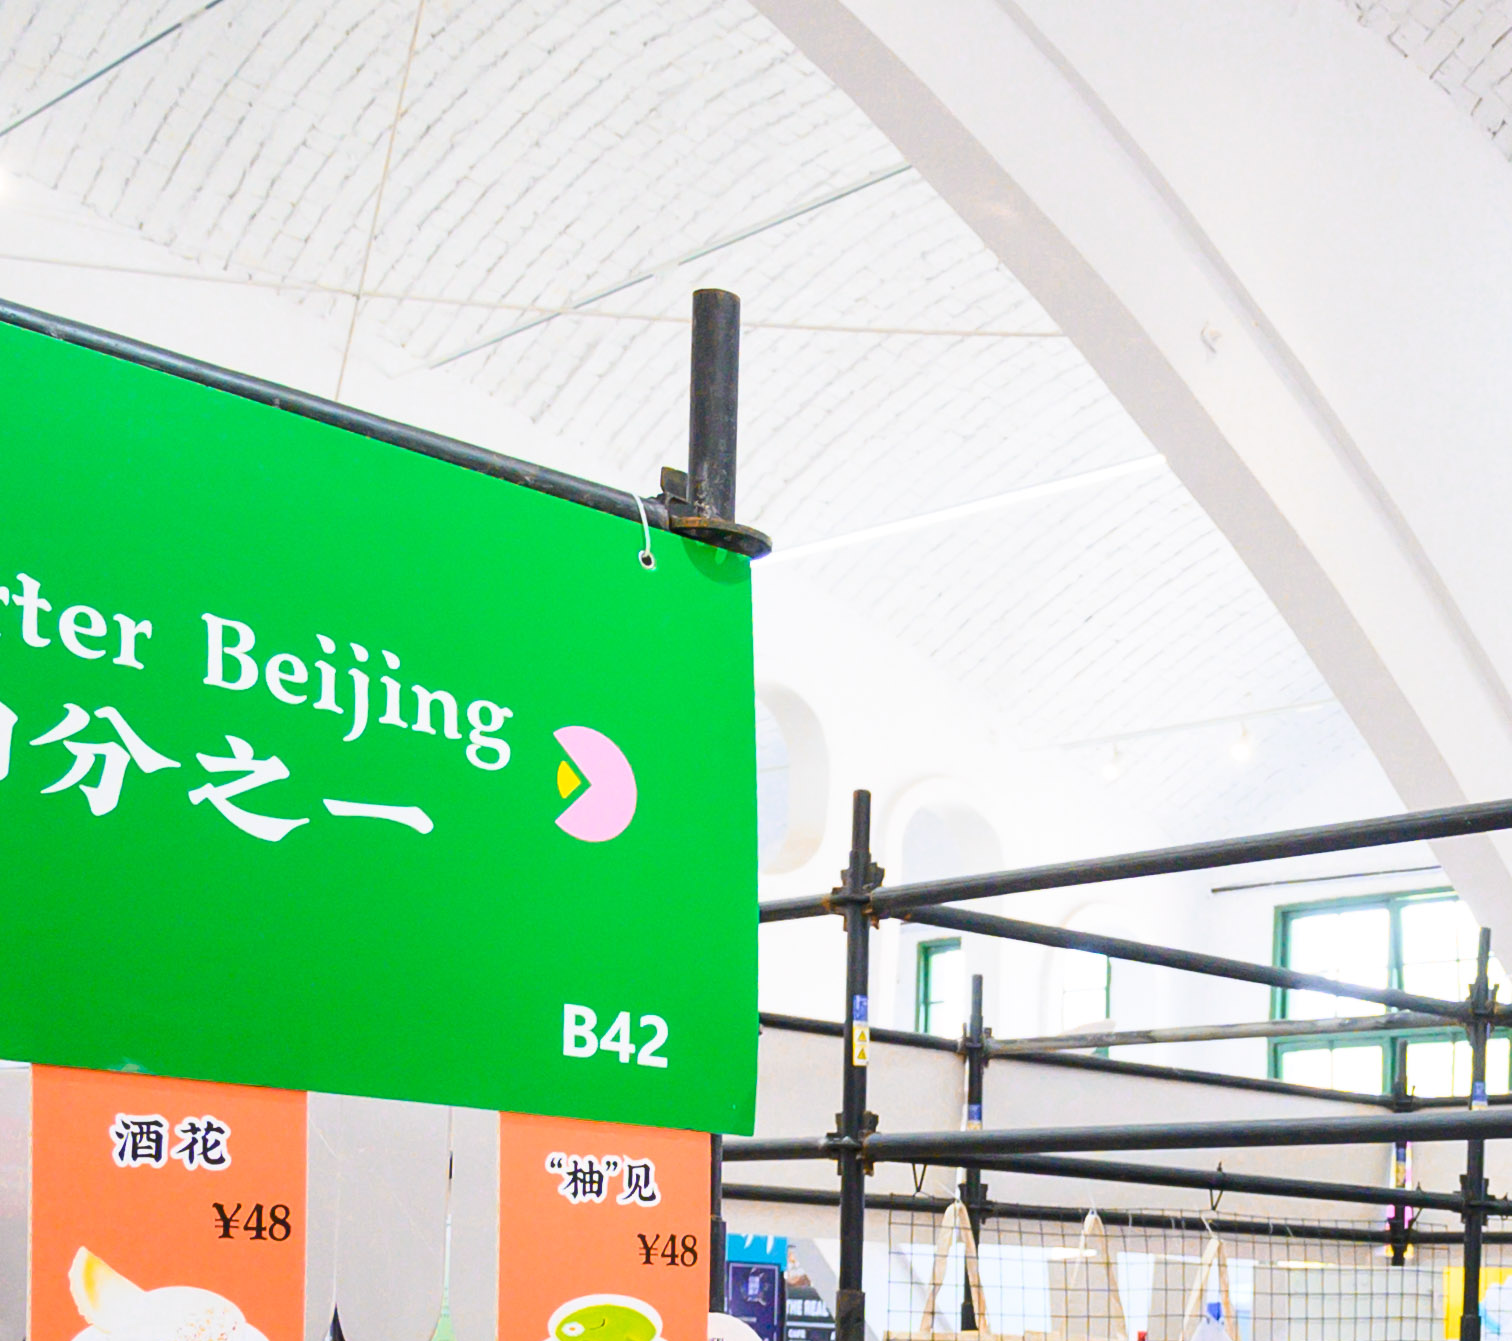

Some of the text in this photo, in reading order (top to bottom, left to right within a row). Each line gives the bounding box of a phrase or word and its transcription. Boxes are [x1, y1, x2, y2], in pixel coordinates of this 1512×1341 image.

[202, 612, 513, 772] Beijing
[561, 1004, 670, 1068] B42
[115, 1118, 227, 1168] 酒花
[212, 1203, 292, 1243] ¥48
[638, 1232, 699, 1268] ¥48
